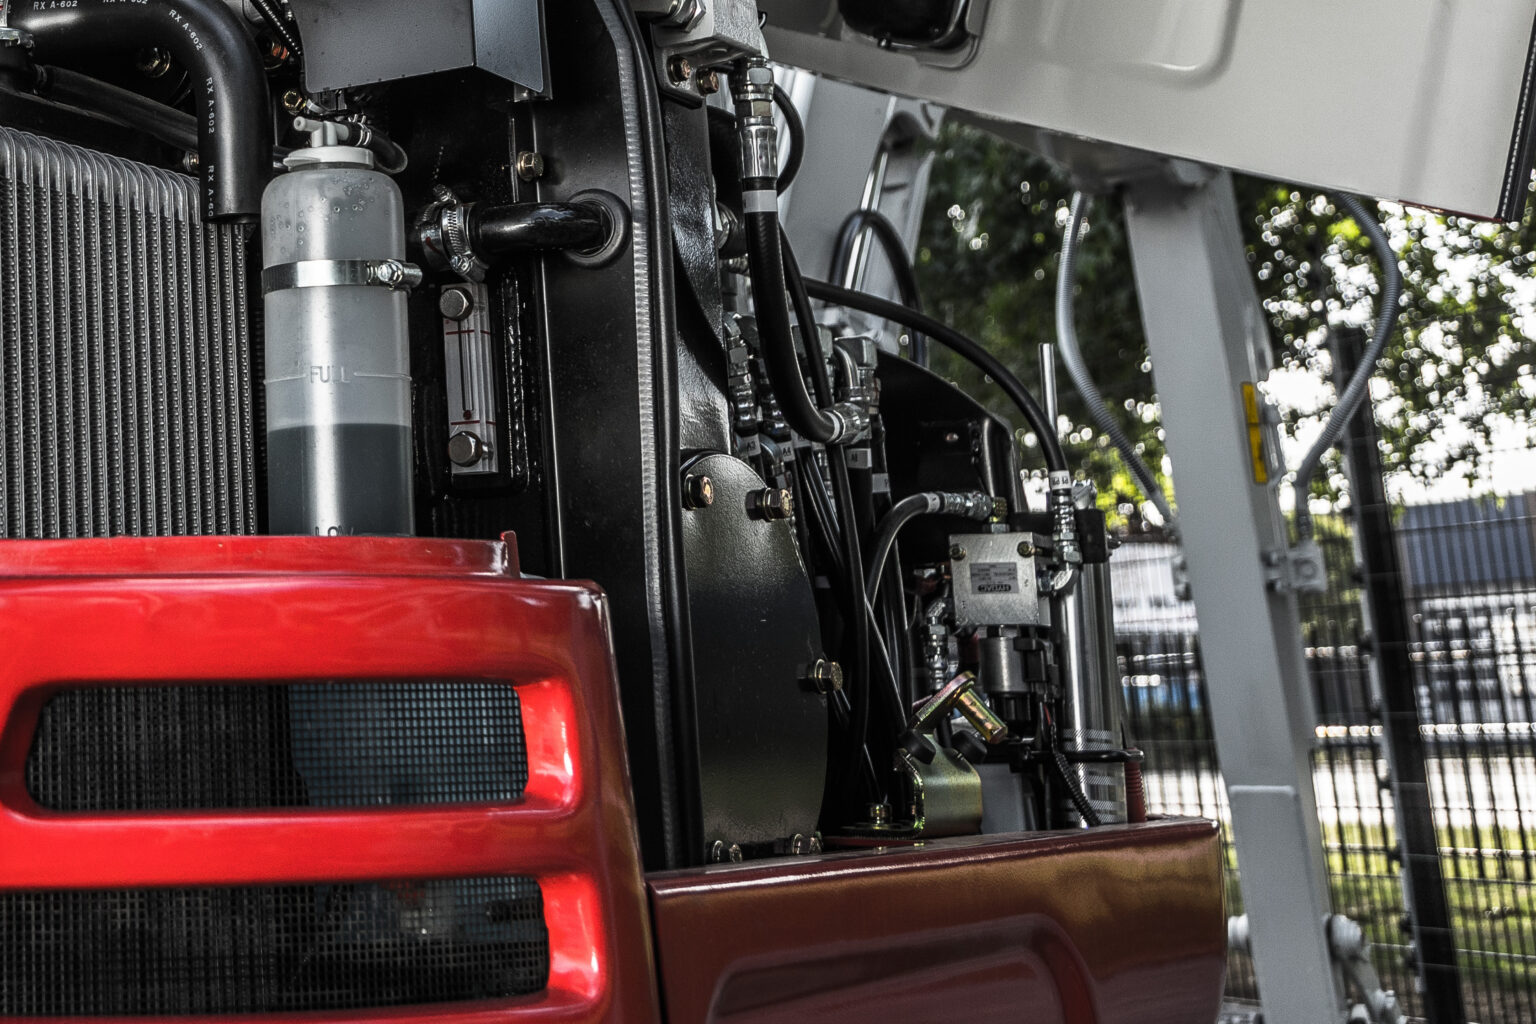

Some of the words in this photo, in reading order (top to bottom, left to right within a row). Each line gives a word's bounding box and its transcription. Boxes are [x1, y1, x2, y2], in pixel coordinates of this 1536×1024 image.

[33, 1, 46, 10] RX
[50, 0, 78, 9] A-602
[168, 9, 182, 22] RX
[182, 22, 203, 51] A-602
[206, 77, 214, 95] RX
[208, 165, 215, 182] RX
[310, 365, 351, 384] FULL
